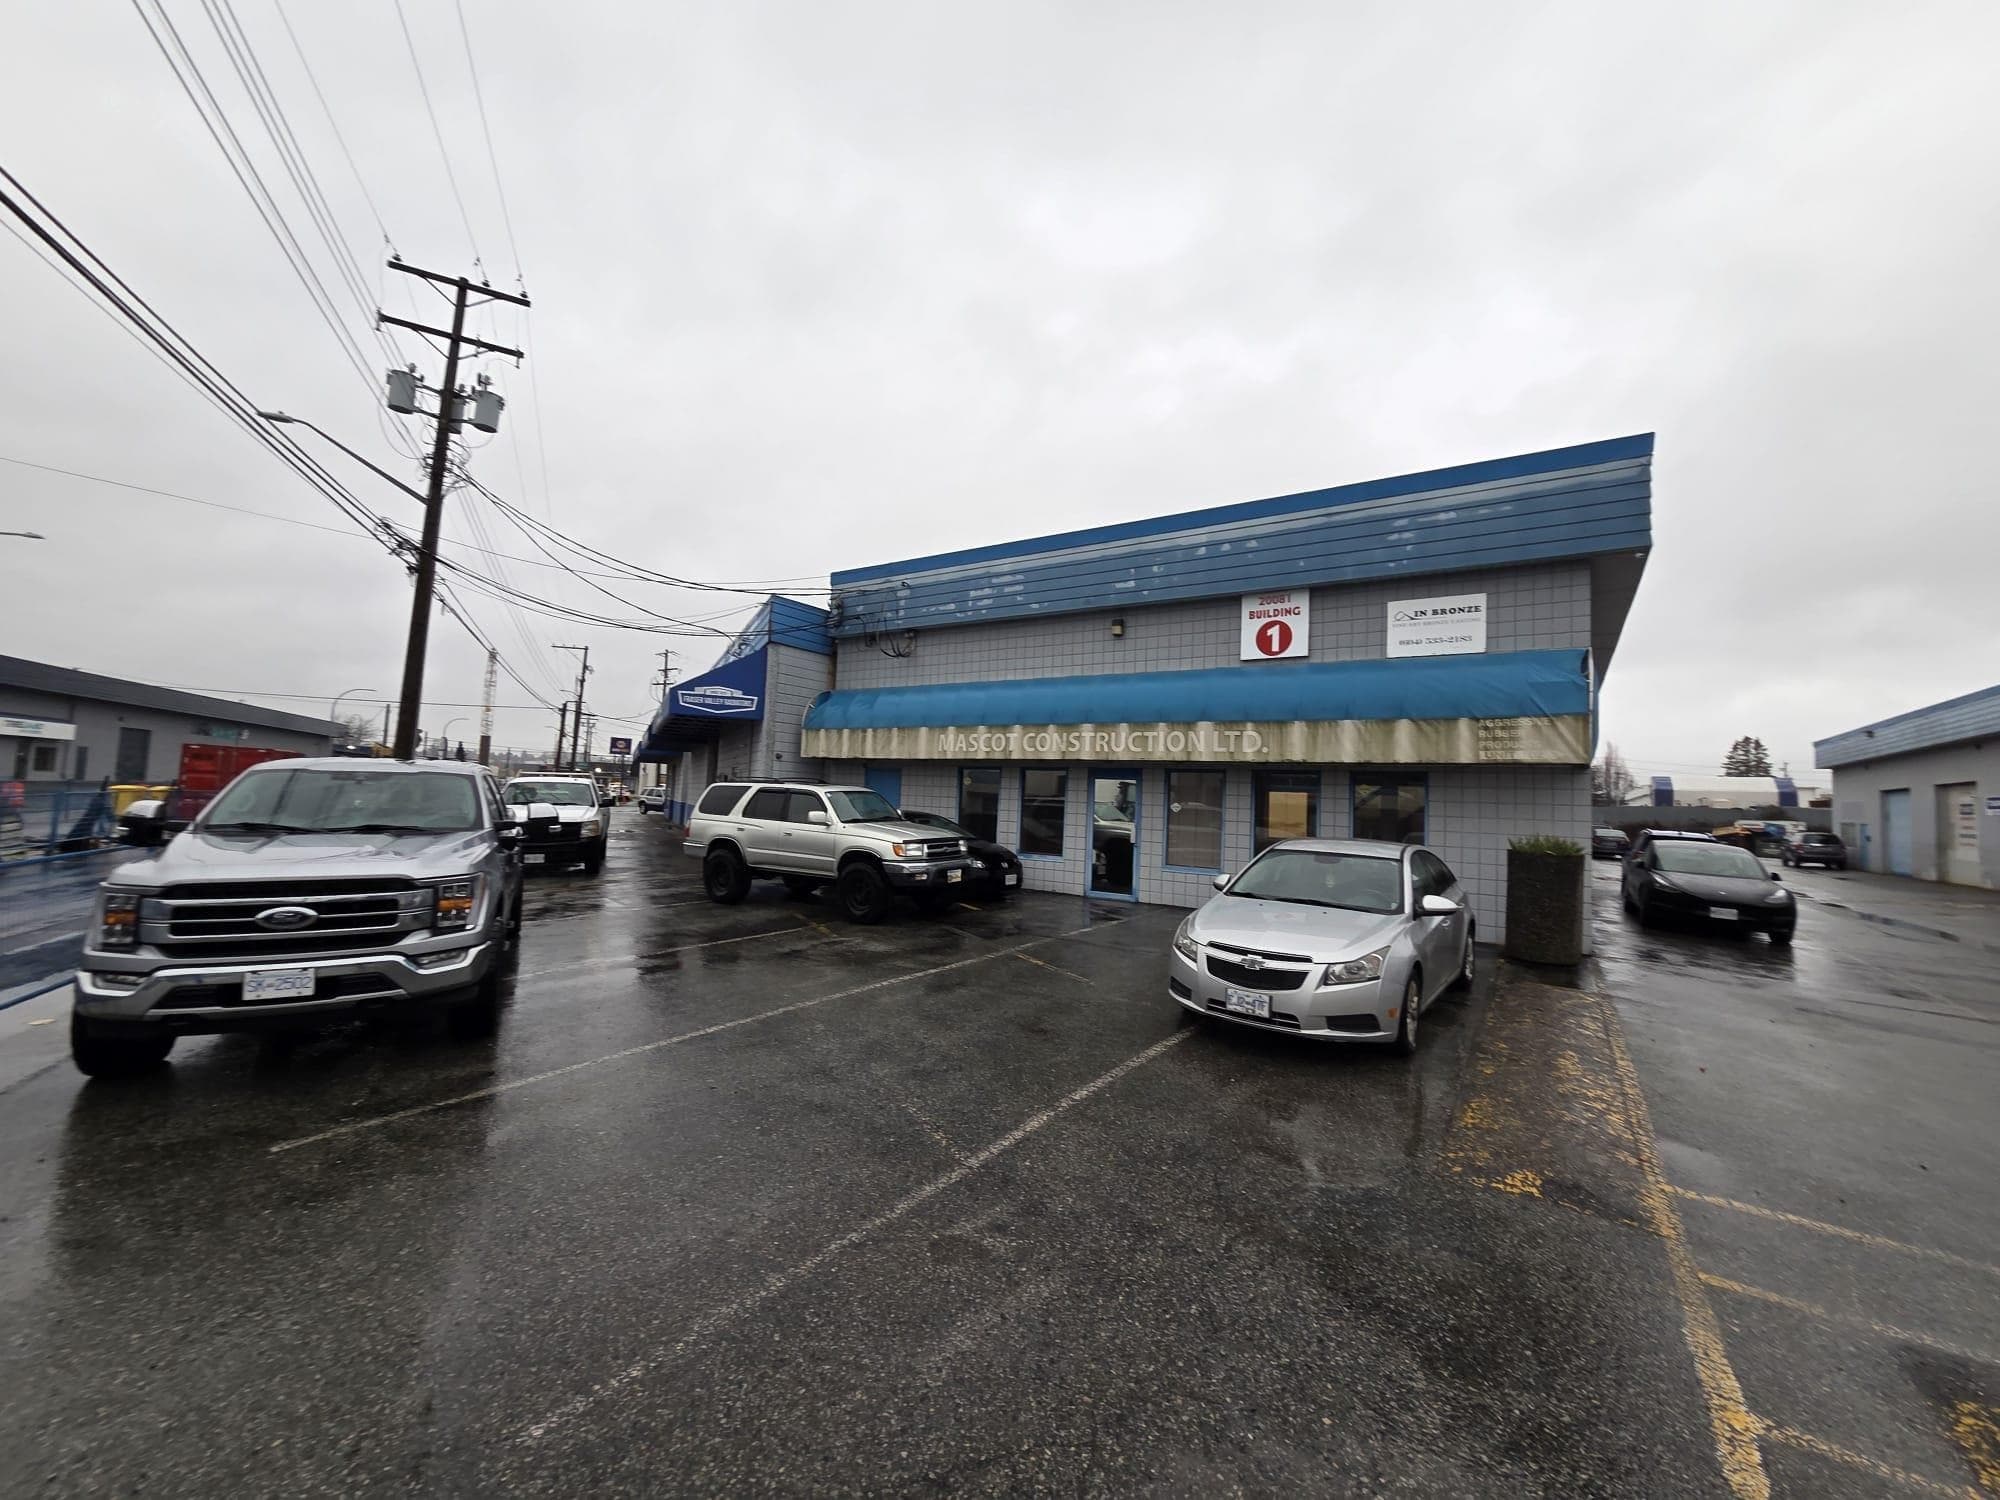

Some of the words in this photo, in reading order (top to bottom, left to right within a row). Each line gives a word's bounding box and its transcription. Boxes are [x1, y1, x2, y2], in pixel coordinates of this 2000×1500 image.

[1258, 592, 1292, 606] 20081
[1248, 606, 1301, 620] BUILDING
[1413, 609, 1428, 618] IN
[1431, 605, 1482, 616] BRONZE
[1266, 623, 1280, 652] 1
[1478, 729, 1525, 739] RUBBE
[938, 732, 1018, 752] MASCOT
[1022, 731, 1205, 752] CONSTRUCTION
[1213, 730, 1269, 753] LTD.
